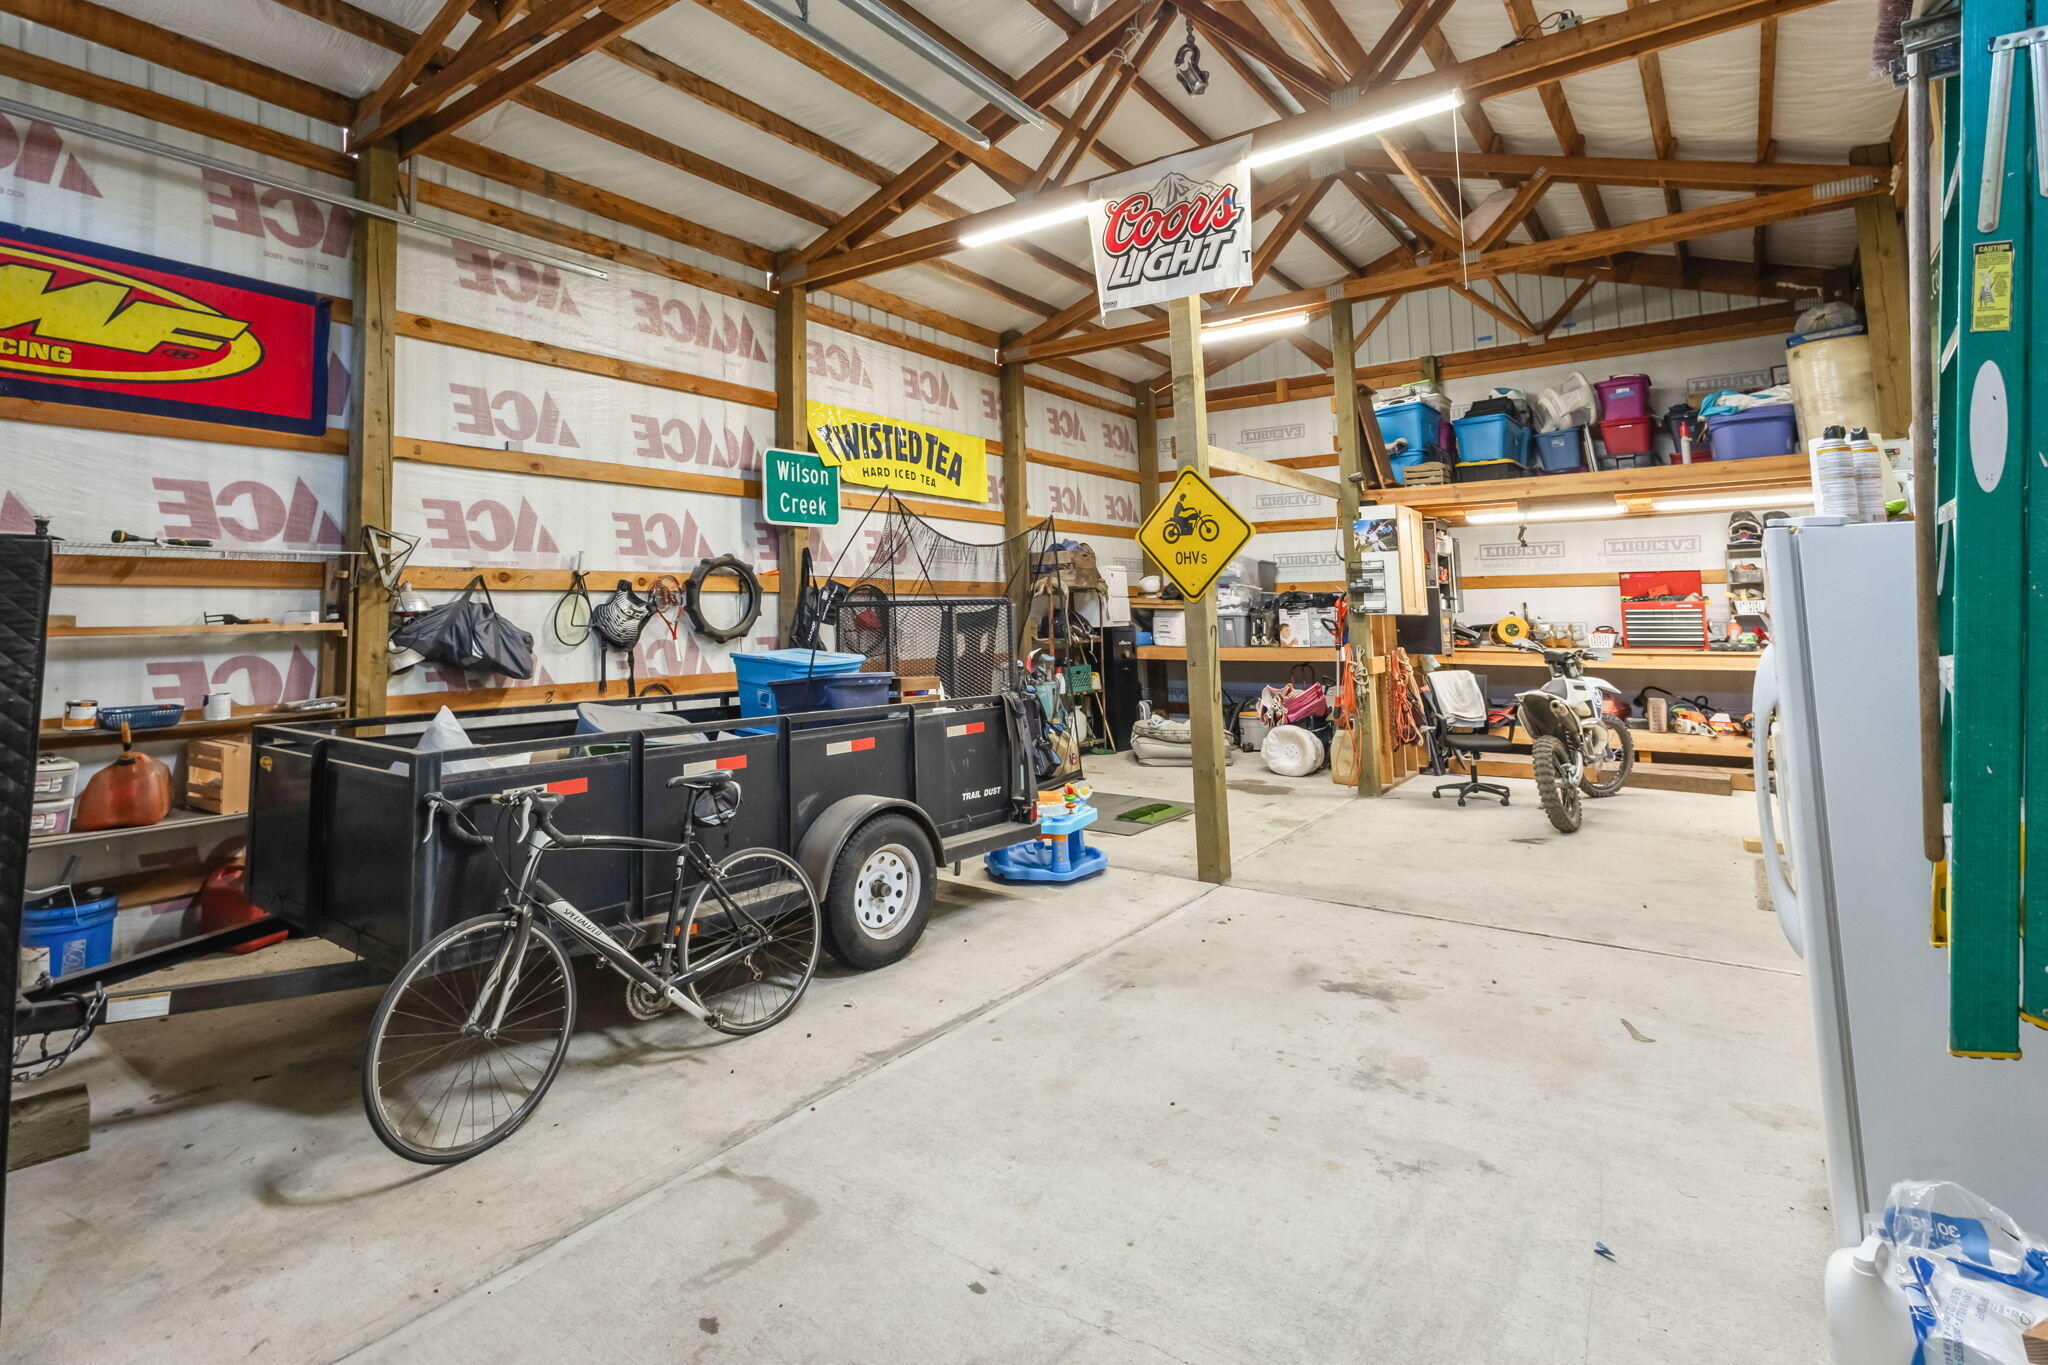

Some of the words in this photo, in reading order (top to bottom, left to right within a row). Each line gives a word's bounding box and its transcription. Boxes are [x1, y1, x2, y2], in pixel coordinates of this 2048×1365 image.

[1103, 184, 1242, 254] Coors
[1107, 230, 1236, 290] LIGHT
[1979, 243, 2010, 253] CAUTION
[925, 432, 963, 487] TEA
[776, 460, 829, 486] Wilson
[862, 467, 890, 478] HARD
[894, 469, 917, 481] ICED
[920, 474, 936, 488] TEA
[780, 492, 827, 517] Creek
[1175, 551, 1208, 565] OHVs
[962, 788, 982, 801] TRAIL
[983, 785, 1002, 797] DUST
